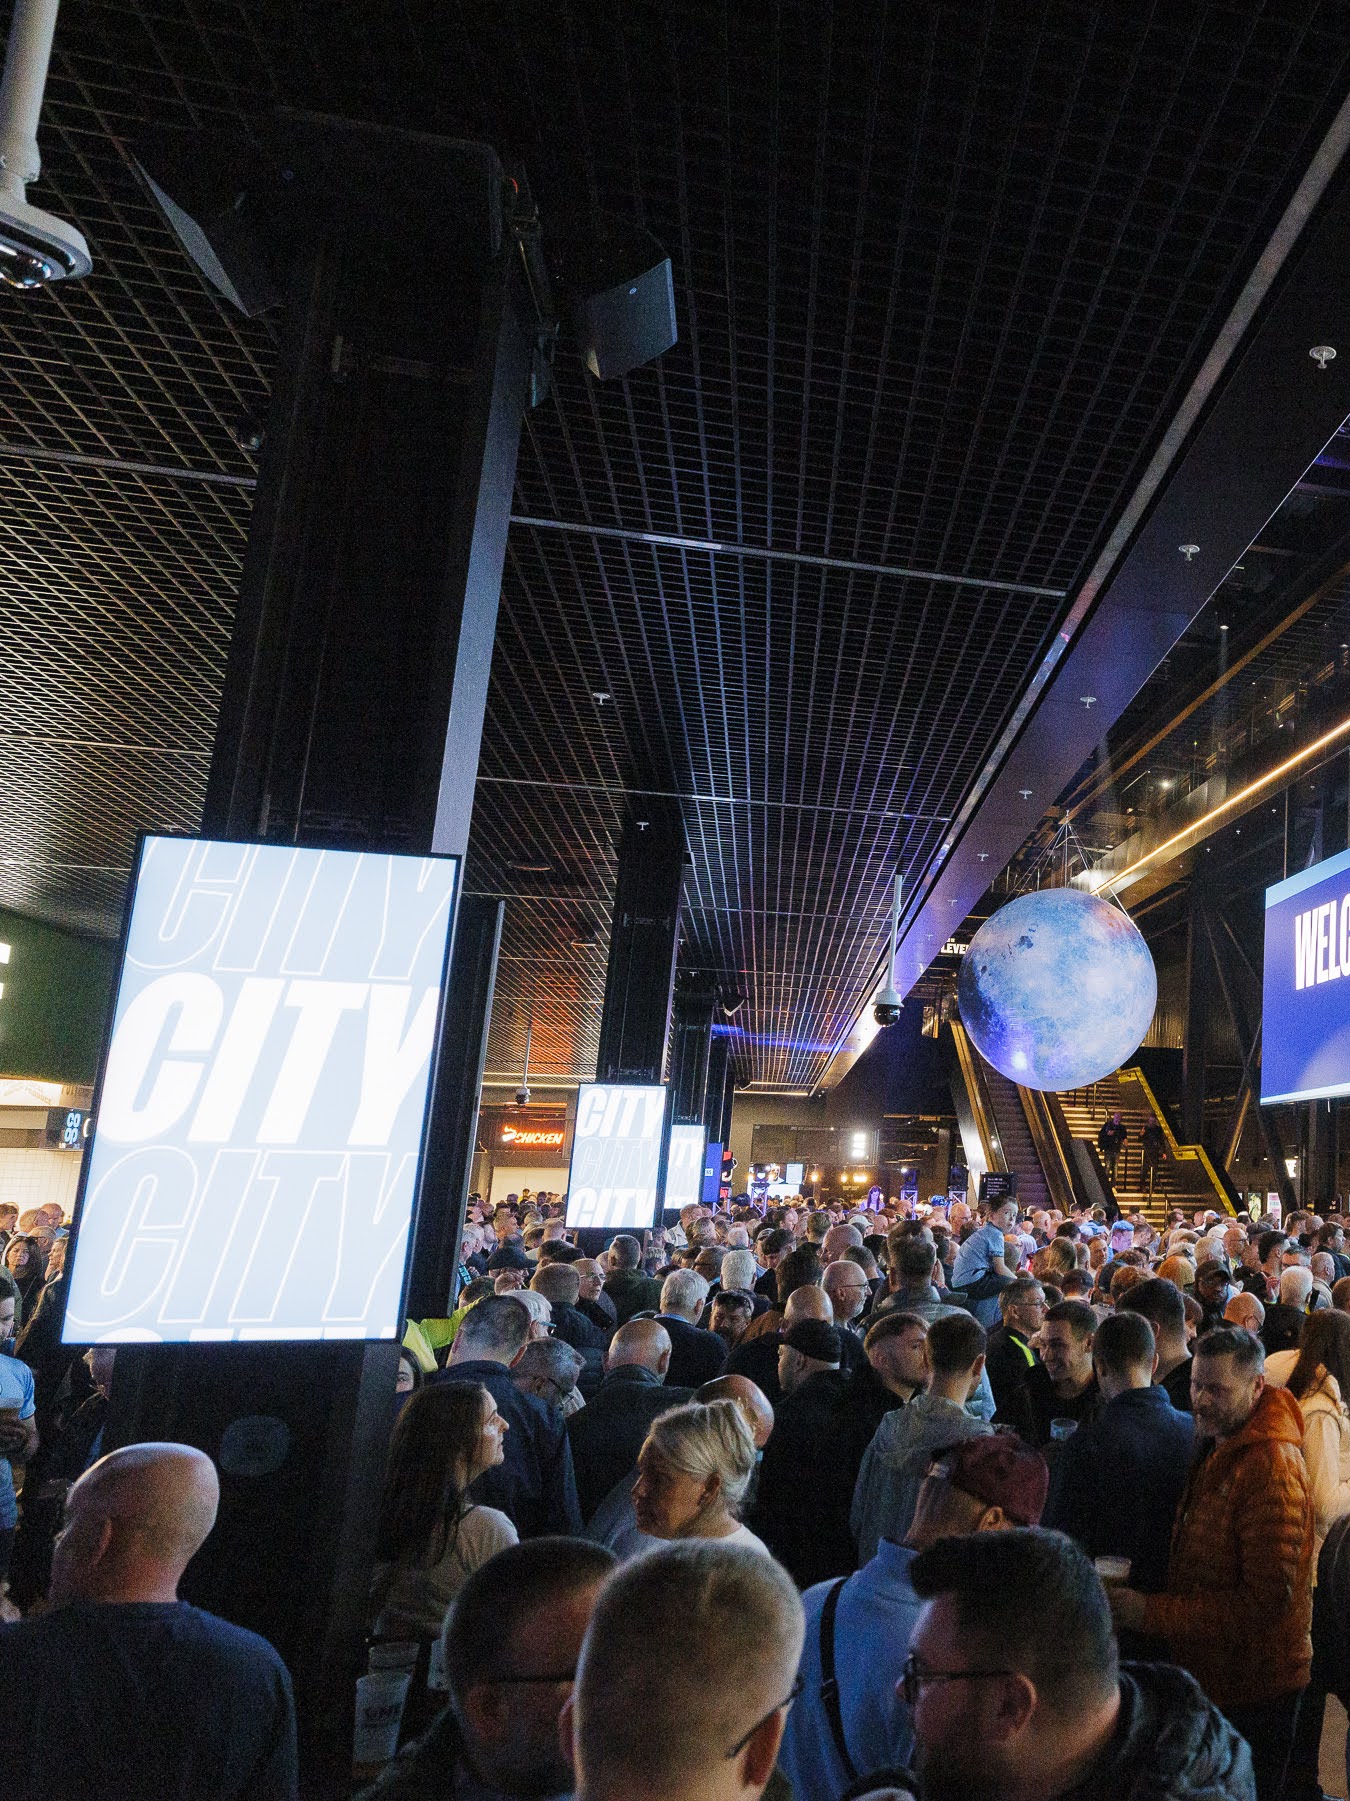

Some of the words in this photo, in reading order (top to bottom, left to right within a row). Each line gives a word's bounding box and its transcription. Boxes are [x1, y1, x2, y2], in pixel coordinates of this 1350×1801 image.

[940, 943, 969, 954] LEVE
[98, 971, 440, 1145] CITY
[515, 1132, 563, 1144] CHICKEN
[575, 1088, 666, 1138] CITY
[570, 1137, 661, 1187] CITY
[566, 1187, 656, 1228] CITY
[66, 1144, 419, 1326] CITY
